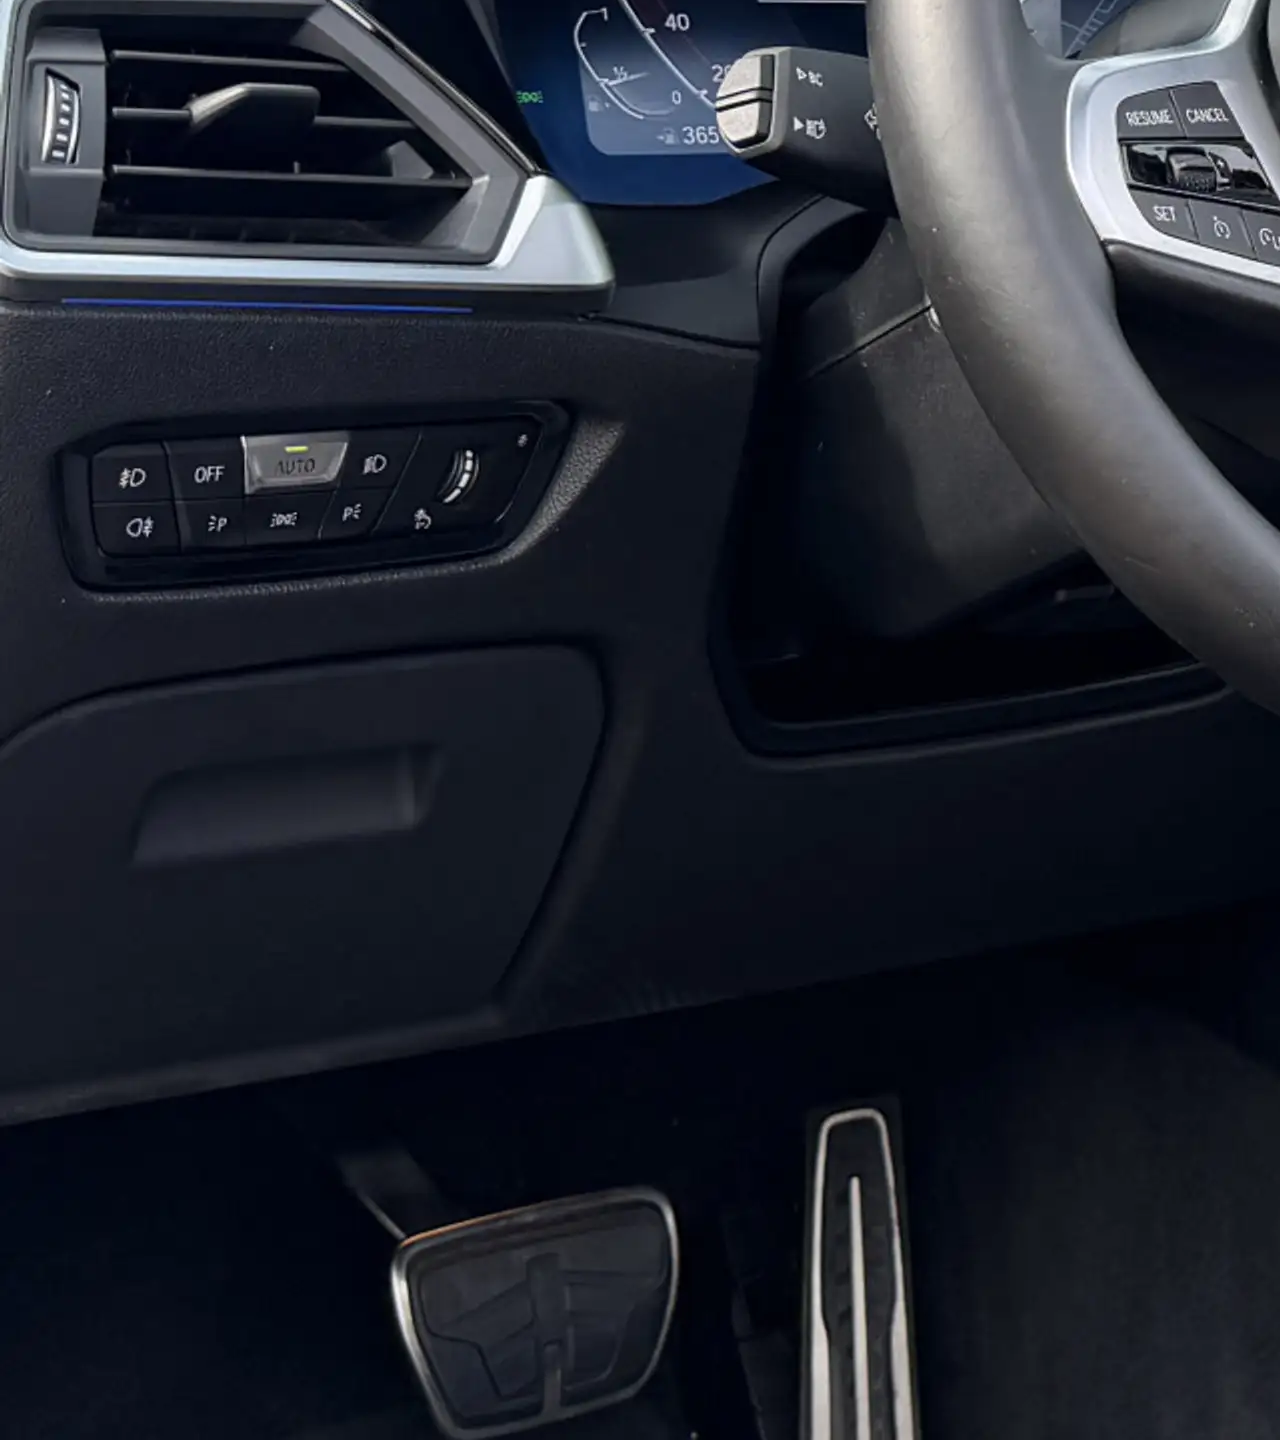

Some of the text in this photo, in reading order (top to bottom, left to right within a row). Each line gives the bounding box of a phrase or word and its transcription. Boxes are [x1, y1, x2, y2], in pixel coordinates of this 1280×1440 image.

[664, 13, 690, 31] 40
[671, 90, 682, 105] 0
[1126, 108, 1174, 127] RESUME
[1186, 109, 1230, 124] CANCEL
[682, 125, 719, 145] 365
[1153, 205, 1177, 222] SET
[194, 465, 226, 483] OFF
[275, 457, 317, 476] AUTO
